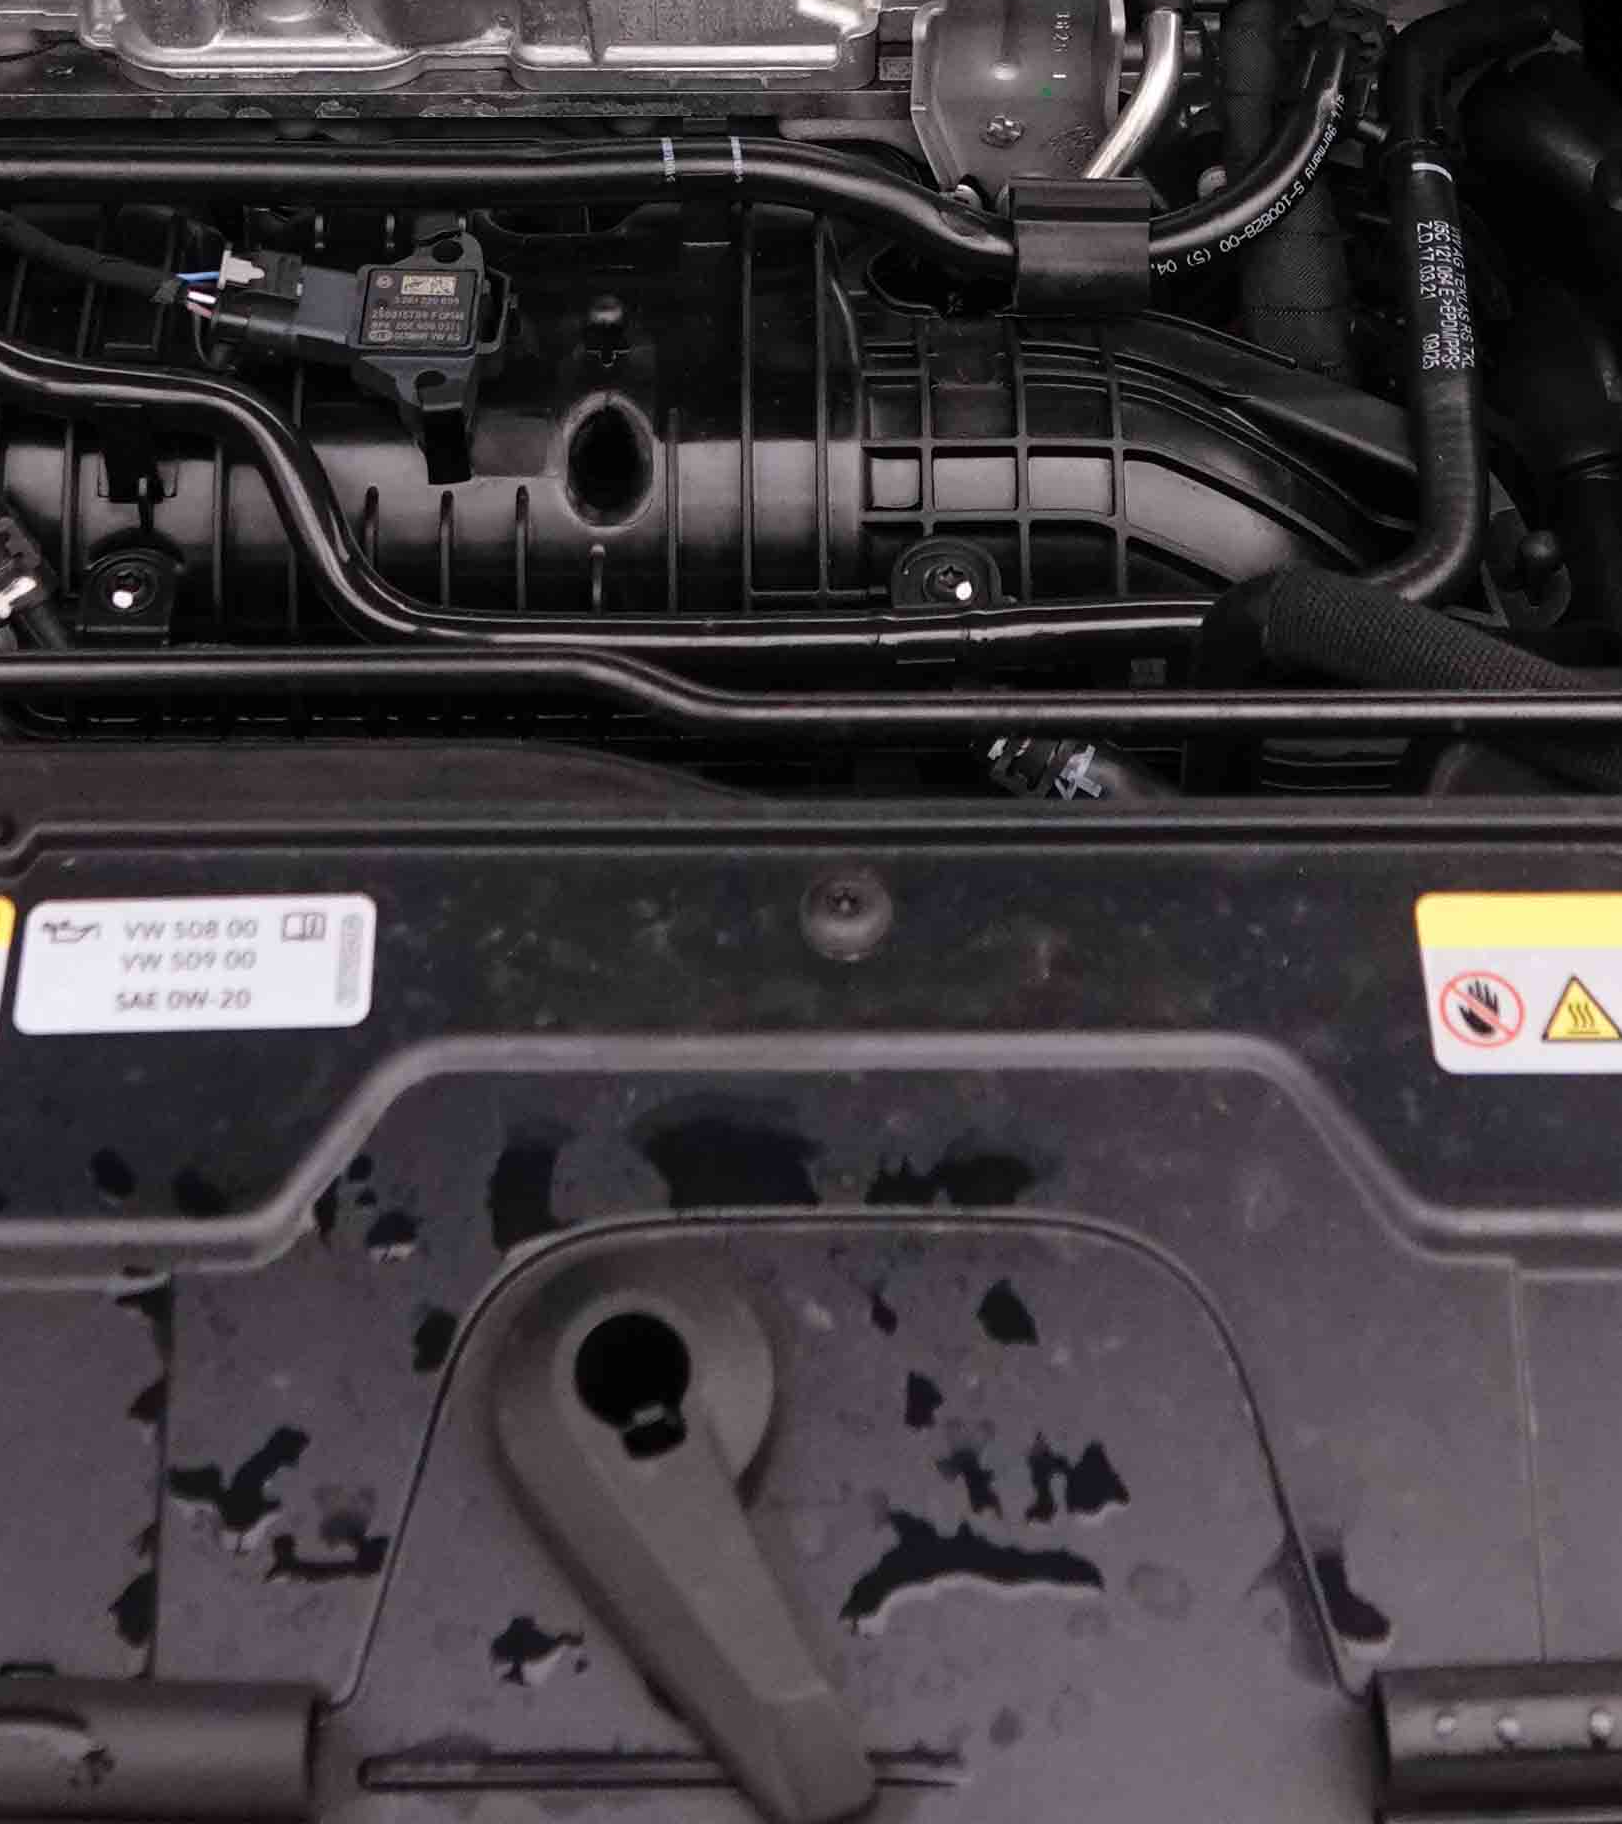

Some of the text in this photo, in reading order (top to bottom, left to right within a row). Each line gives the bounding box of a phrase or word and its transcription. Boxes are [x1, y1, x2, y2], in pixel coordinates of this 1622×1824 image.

[1185, 247, 1212, 268] (5)
[1436, 244, 1453, 263] 121
[123, 919, 259, 940] VW 508 00
[120, 950, 257, 972] VW 509 00
[114, 991, 158, 1010] SAE
